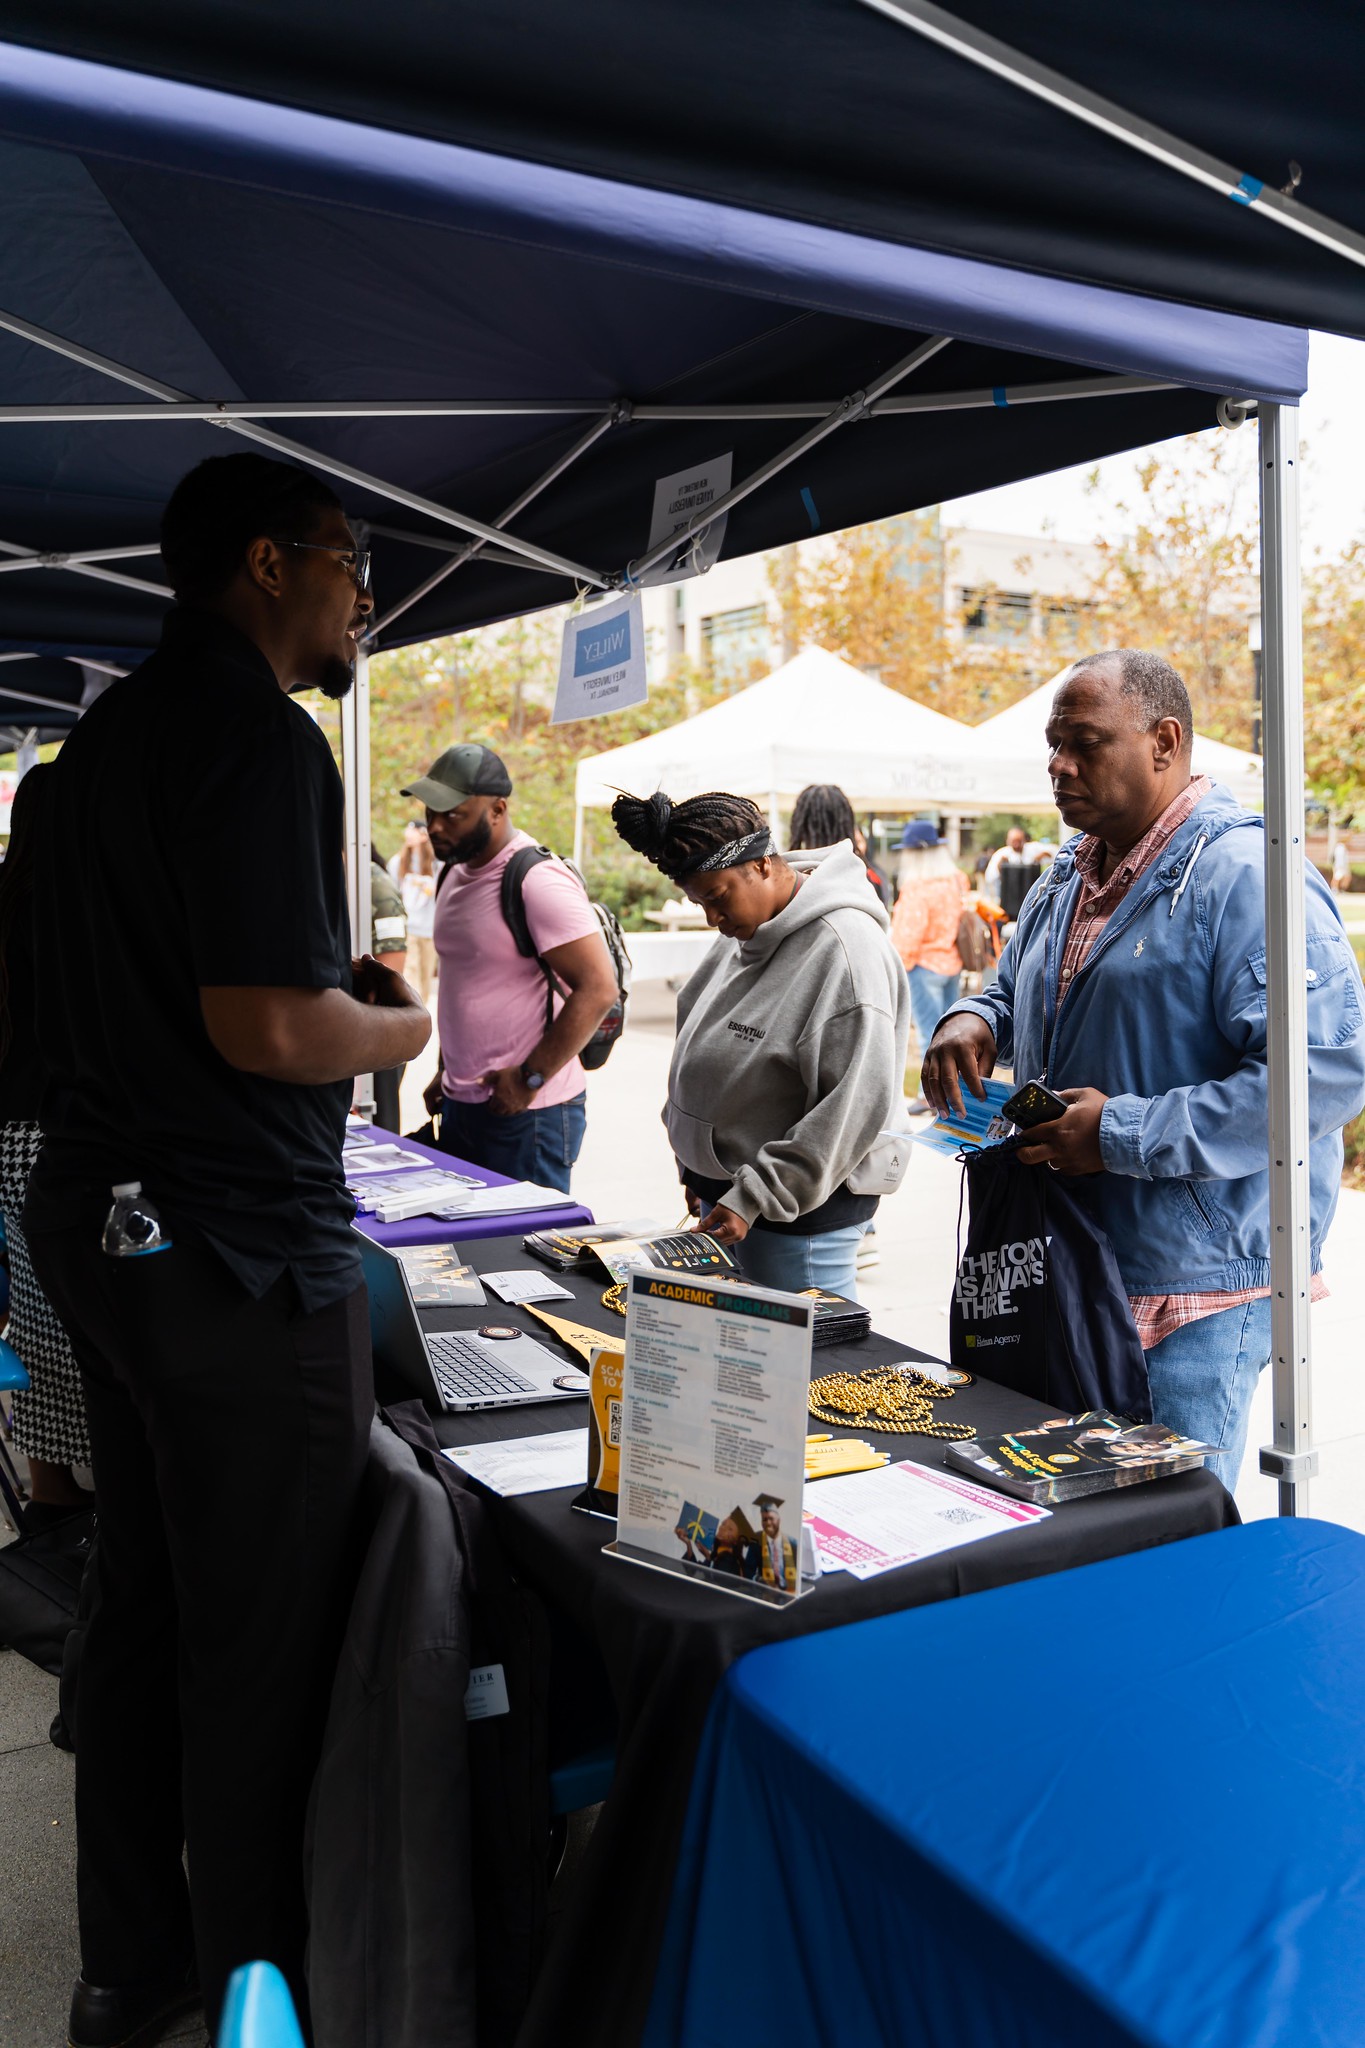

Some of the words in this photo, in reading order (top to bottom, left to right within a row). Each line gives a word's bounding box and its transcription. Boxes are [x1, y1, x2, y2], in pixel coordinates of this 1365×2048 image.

[958, 1250, 998, 1278] THE
[997, 1236, 1053, 1270] TORY
[956, 1275, 979, 1298] IS
[648, 1281, 715, 1307] ACADEMIC
[716, 1295, 791, 1322] PROGRAMS
[993, 1334, 1021, 1346] Agency
[602, 1375, 617, 1388] TO
[472, 1672, 494, 1684] IER
